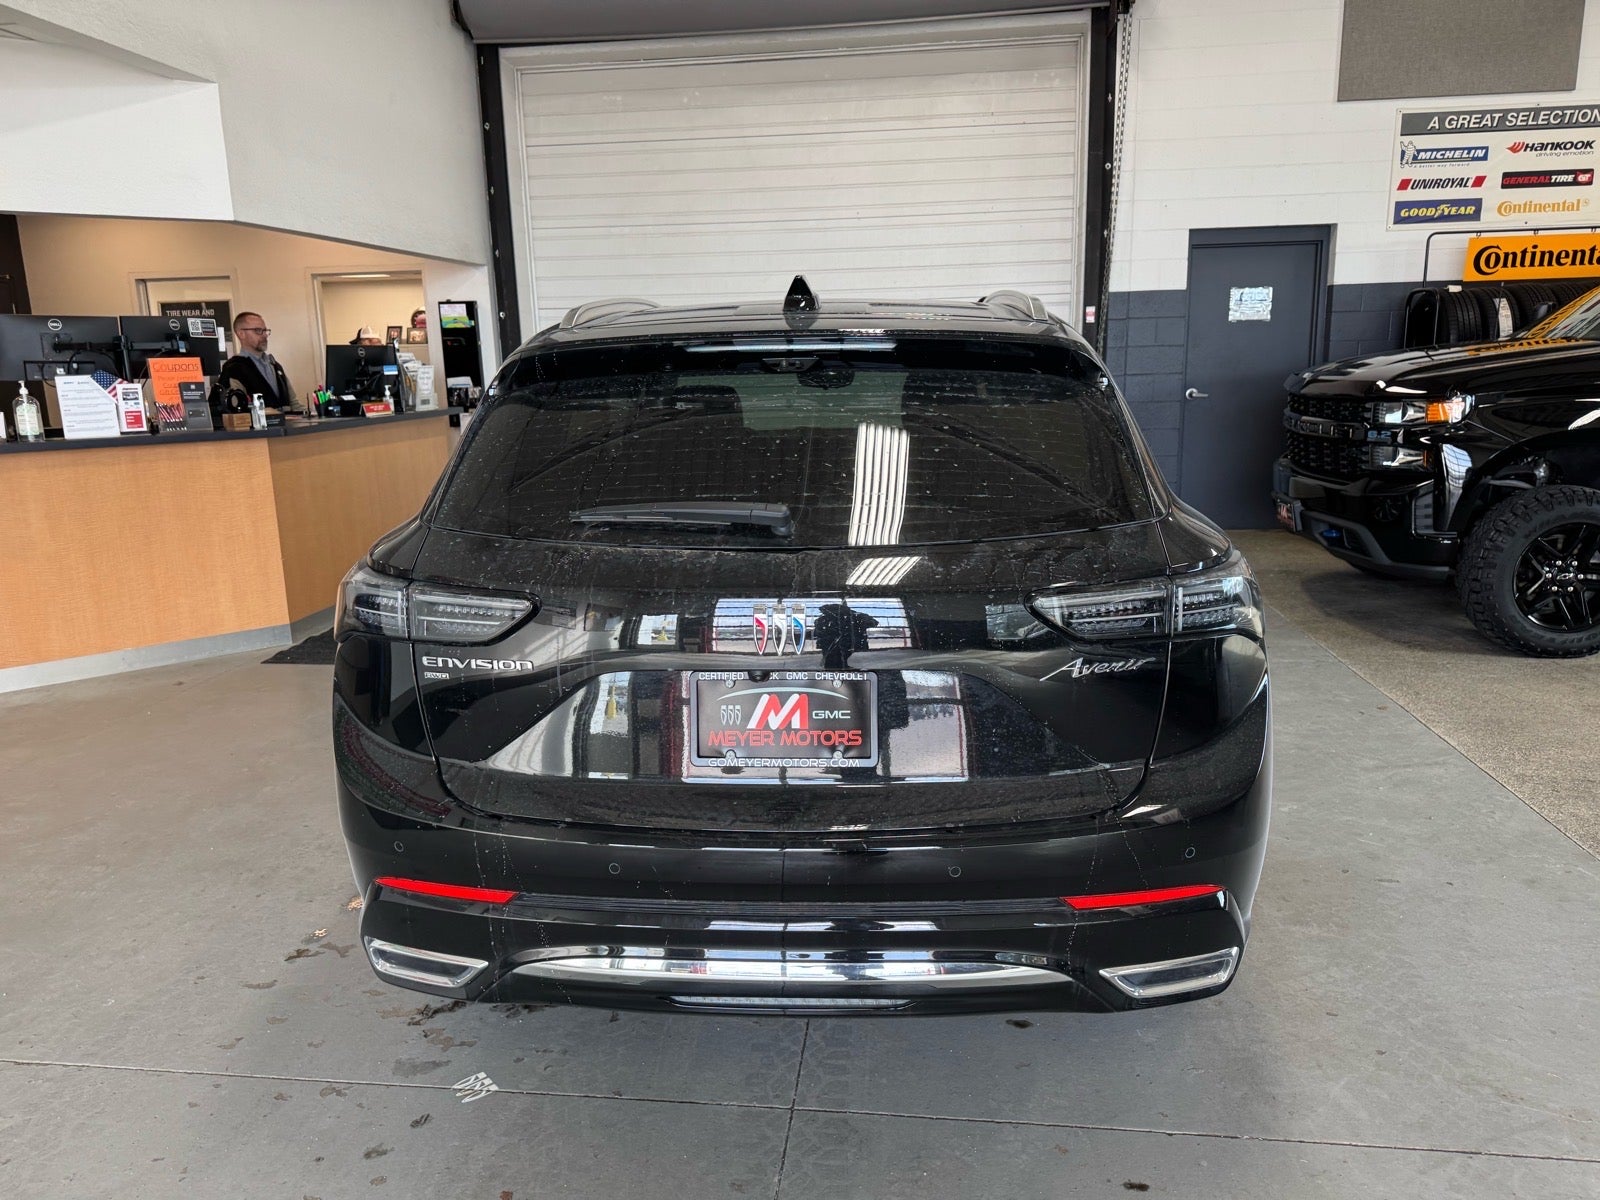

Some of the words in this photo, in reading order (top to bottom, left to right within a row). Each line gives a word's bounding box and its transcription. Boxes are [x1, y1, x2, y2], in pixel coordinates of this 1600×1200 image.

[1427, 116, 1440, 130] A
[1445, 113, 1503, 129] GREAT
[1505, 108, 1600, 126] SELECTION
[1417, 149, 1486, 160] MICHELIN
[1410, 177, 1470, 190] UNIROYAL
[1577, 173, 1592, 182] GT
[1400, 204, 1476, 218] GOODYEAR
[1496, 198, 1581, 217] Continental
[1473, 244, 1600, 276] Continent
[153, 363, 199, 372] Coupons
[1367, 430, 1392, 439] 6.2
[1039, 657, 1156, 681] Avenir
[699, 672, 744, 680] CERTIFIED
[786, 672, 808, 680] GMC
[815, 672, 867, 681] CHEVROLET
[812, 710, 851, 719] GMC
[708, 730, 774, 747] MEYER
[780, 730, 862, 747] MOTORS
[708, 758, 860, 768] GOMEYERMOTORS.COM
